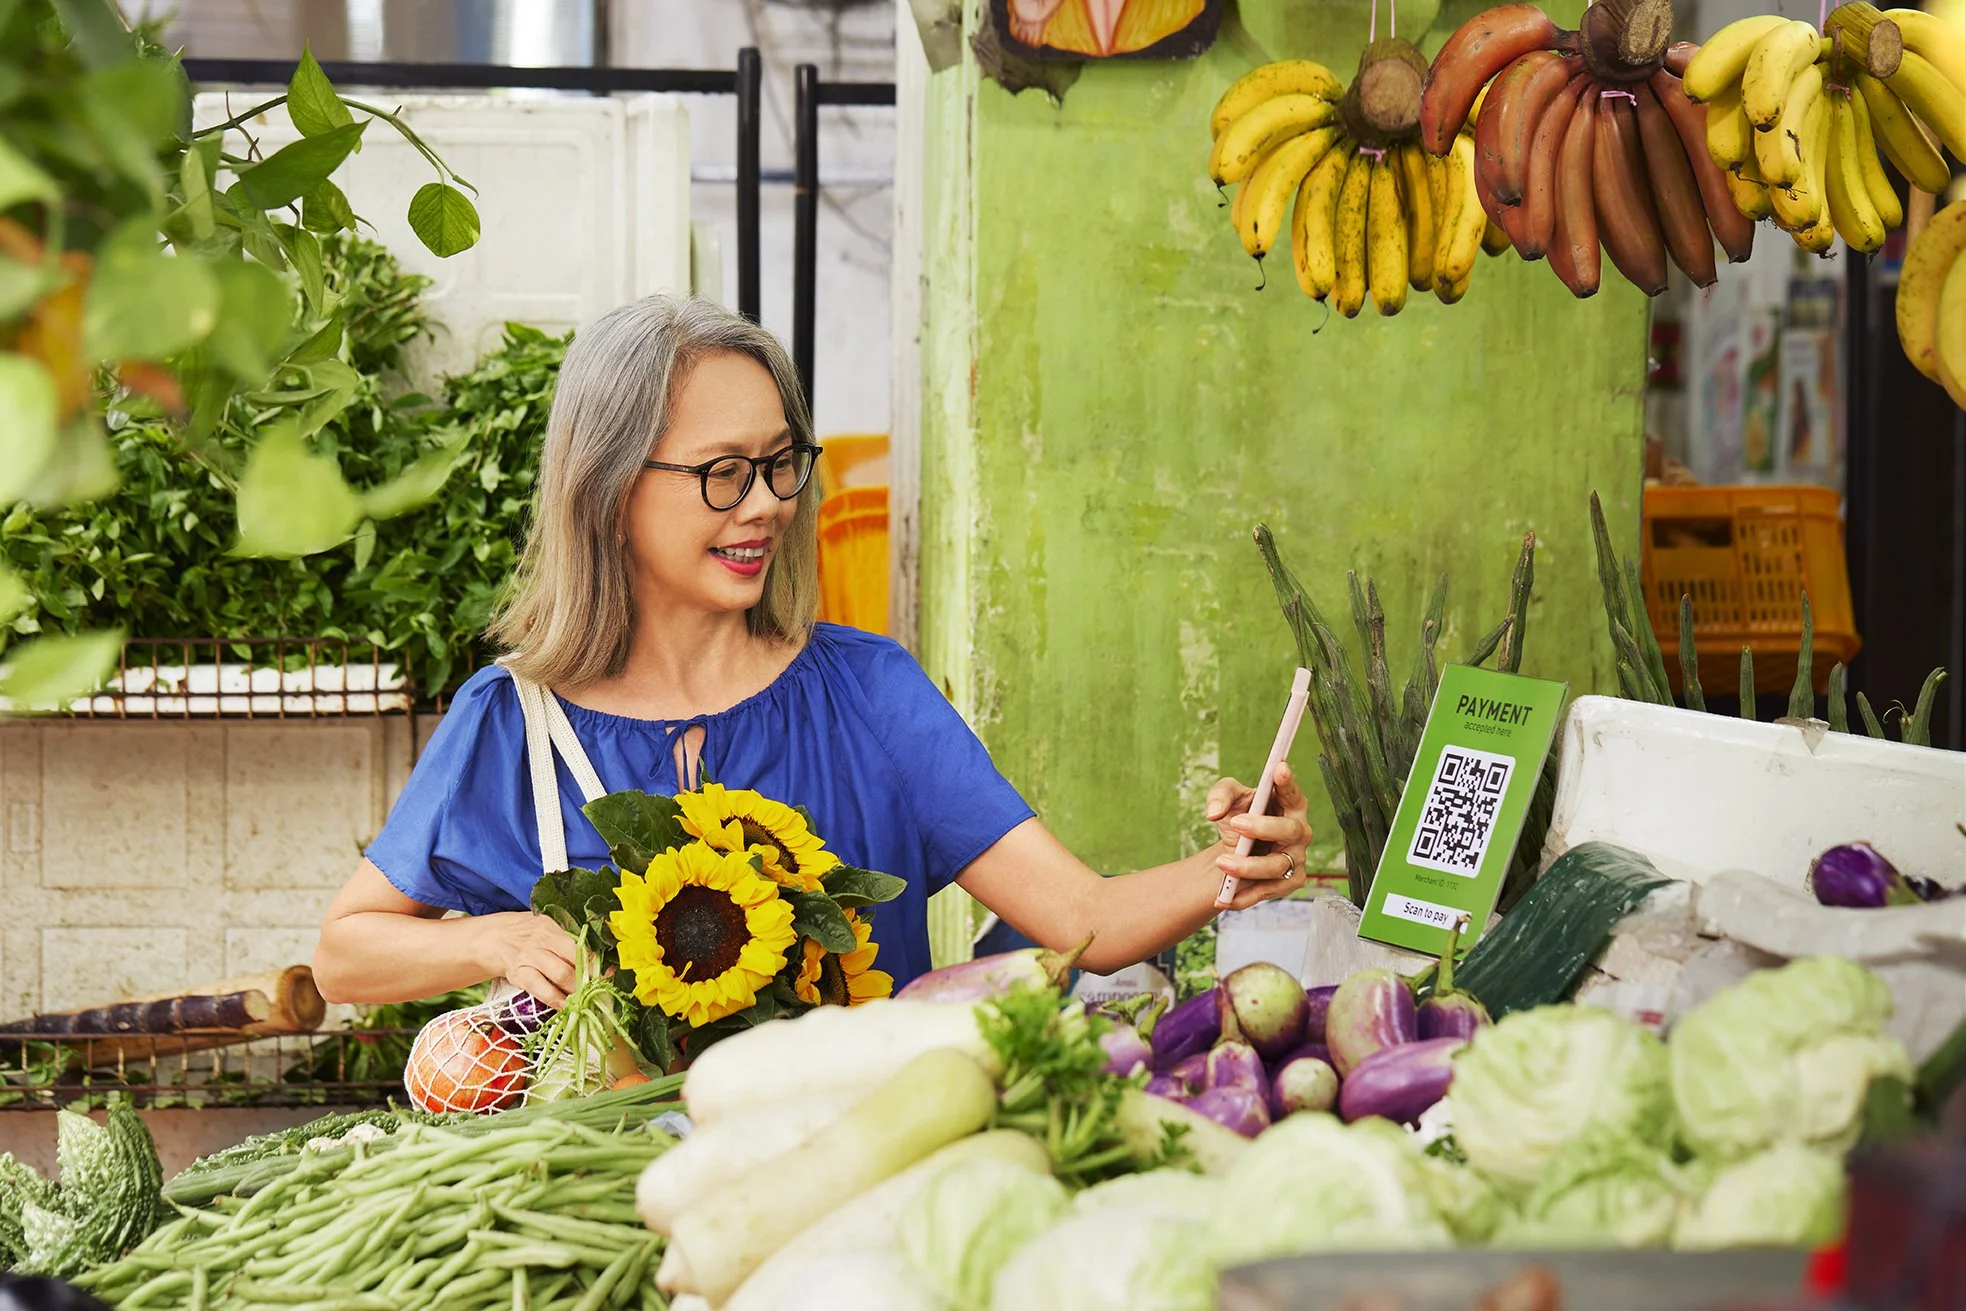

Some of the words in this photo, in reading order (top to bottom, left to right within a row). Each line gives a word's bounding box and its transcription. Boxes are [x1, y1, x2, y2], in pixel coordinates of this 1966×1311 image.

[1456, 694, 1533, 726] PAYMENT
[1464, 721, 1496, 735] accepted
[1496, 725, 1512, 738] here
[1403, 901, 1423, 916] Scan
[1424, 908, 1433, 918] to
[1432, 911, 1449, 925] pay
